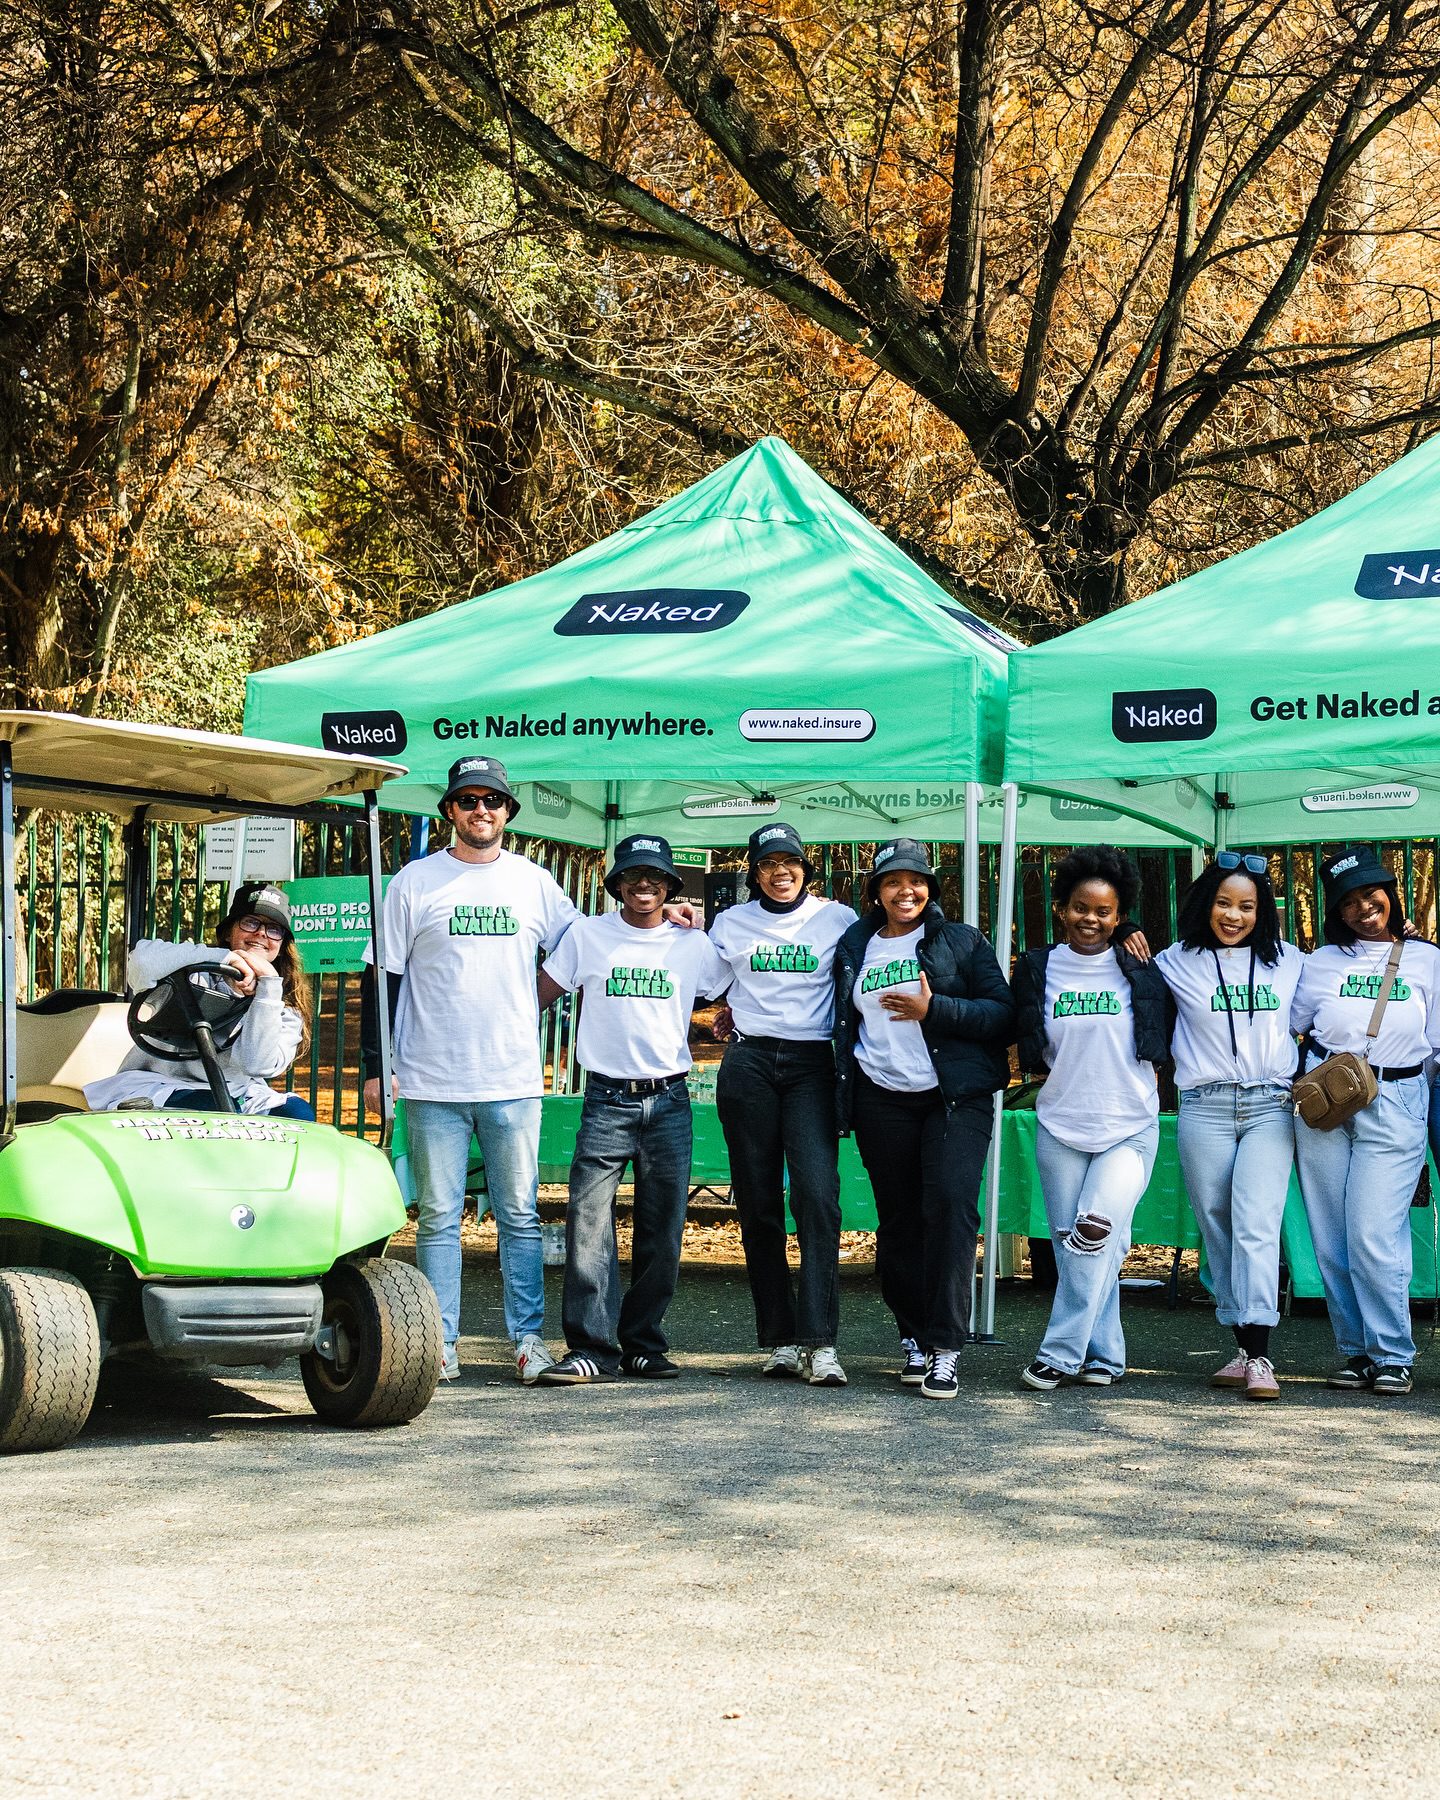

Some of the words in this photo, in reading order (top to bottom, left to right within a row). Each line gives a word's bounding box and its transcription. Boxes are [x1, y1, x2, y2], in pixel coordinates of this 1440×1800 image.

[587, 601, 724, 624] Naked
[1250, 696, 1308, 721] Get
[1316, 690, 1420, 719] Naked
[748, 716, 862, 729] www.naked.insure
[1124, 703, 1203, 728] Naked
[433, 717, 479, 740] Get
[485, 713, 567, 738] Naked
[572, 711, 714, 740] anywhere.
[331, 723, 397, 745] Naked
[290, 903, 337, 917] NAKED
[340, 902, 371, 916] PEO
[455, 906, 473, 917] EK
[475, 906, 493, 918] EN
[496, 906, 512, 918] JY
[294, 916, 338, 932] DON'T
[341, 917, 372, 931] WAL
[449, 917, 520, 936] NAKED
[776, 944, 794, 955] EN
[750, 954, 819, 973] NAKED
[612, 967, 630, 979] EK
[632, 968, 650, 980] EN
[651, 969, 669, 981] JY
[1347, 975, 1366, 985] EK
[606, 978, 674, 999] NAKED
[1059, 991, 1077, 1002] EK
[1078, 992, 1097, 1001] EN
[1098, 991, 1116, 1001] JY
[1257, 984, 1272, 994] JY
[1053, 1000, 1122, 1019] NAKED
[111, 1118, 206, 1128] NAKED
[209, 1118, 307, 1133] PEOPLE
[139, 1127, 173, 1140] IN
[178, 1127, 297, 1144] TRANSIT.
